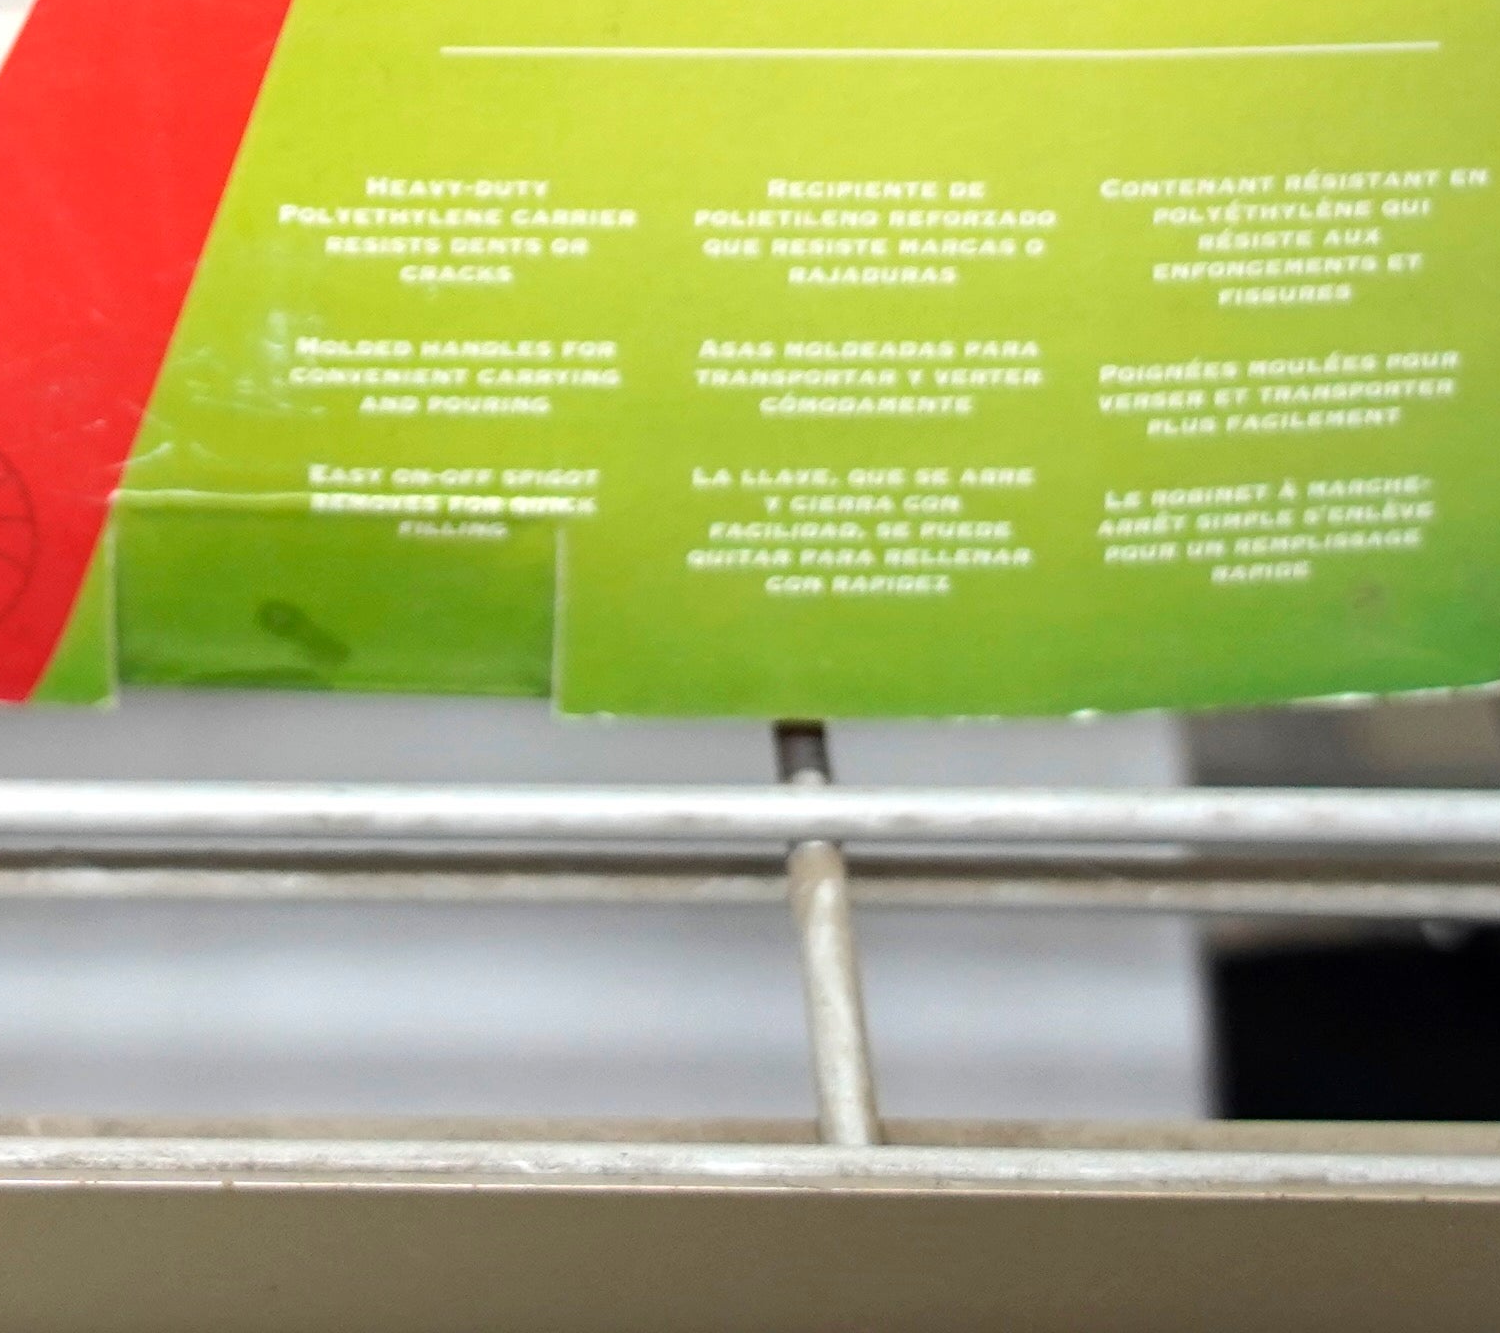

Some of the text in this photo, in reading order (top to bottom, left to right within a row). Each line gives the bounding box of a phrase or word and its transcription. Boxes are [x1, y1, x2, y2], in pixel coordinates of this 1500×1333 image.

[366, 176, 549, 197] HEAVY-DUTY
[767, 178, 986, 199] RECIPIENTE DE
[1100, 168, 1488, 199] CONTENANT RÉSISTANT EN
[279, 204, 638, 226] POLYETHYLENE CARRIER
[694, 209, 1057, 228] POLIETILENO REFORZADO
[1153, 197, 1431, 225] POLYÉTHYLÈNE QUI
[325, 236, 589, 254] RESISTS DENTS OR
[702, 237, 1045, 257] QUE RESISTE MARCAS O
[1198, 227, 1381, 251] RÉSISTE AUX
[400, 265, 513, 283] CRACKS
[788, 266, 957, 284] RAJADURAS
[1152, 252, 1423, 281] ENFONCEMENTS ET
[1218, 283, 1352, 305] FISSURES
[295, 337, 616, 358] MOLDED HANDLES FOR
[698, 339, 775, 358] ASAS
[964, 340, 1039, 358] PARA
[288, 367, 621, 386] CONVENIENT CARRYING
[1100, 350, 1460, 383] POIGNÉES MOULÉES POUR
[695, 368, 1043, 387] TRANSPORTAR Y VERTER
[360, 395, 550, 414] AND POURING
[1098, 377, 1455, 412] VERSER ET TRANSPORTER
[1147, 406, 1401, 436] PLUS FACILEMENT
[307, 464, 381, 485] EASY
[501, 468, 599, 487] SPIGOT
[691, 466, 732, 488] LA
[847, 468, 905, 487] QUE
[1104, 489, 1141, 510] LE
